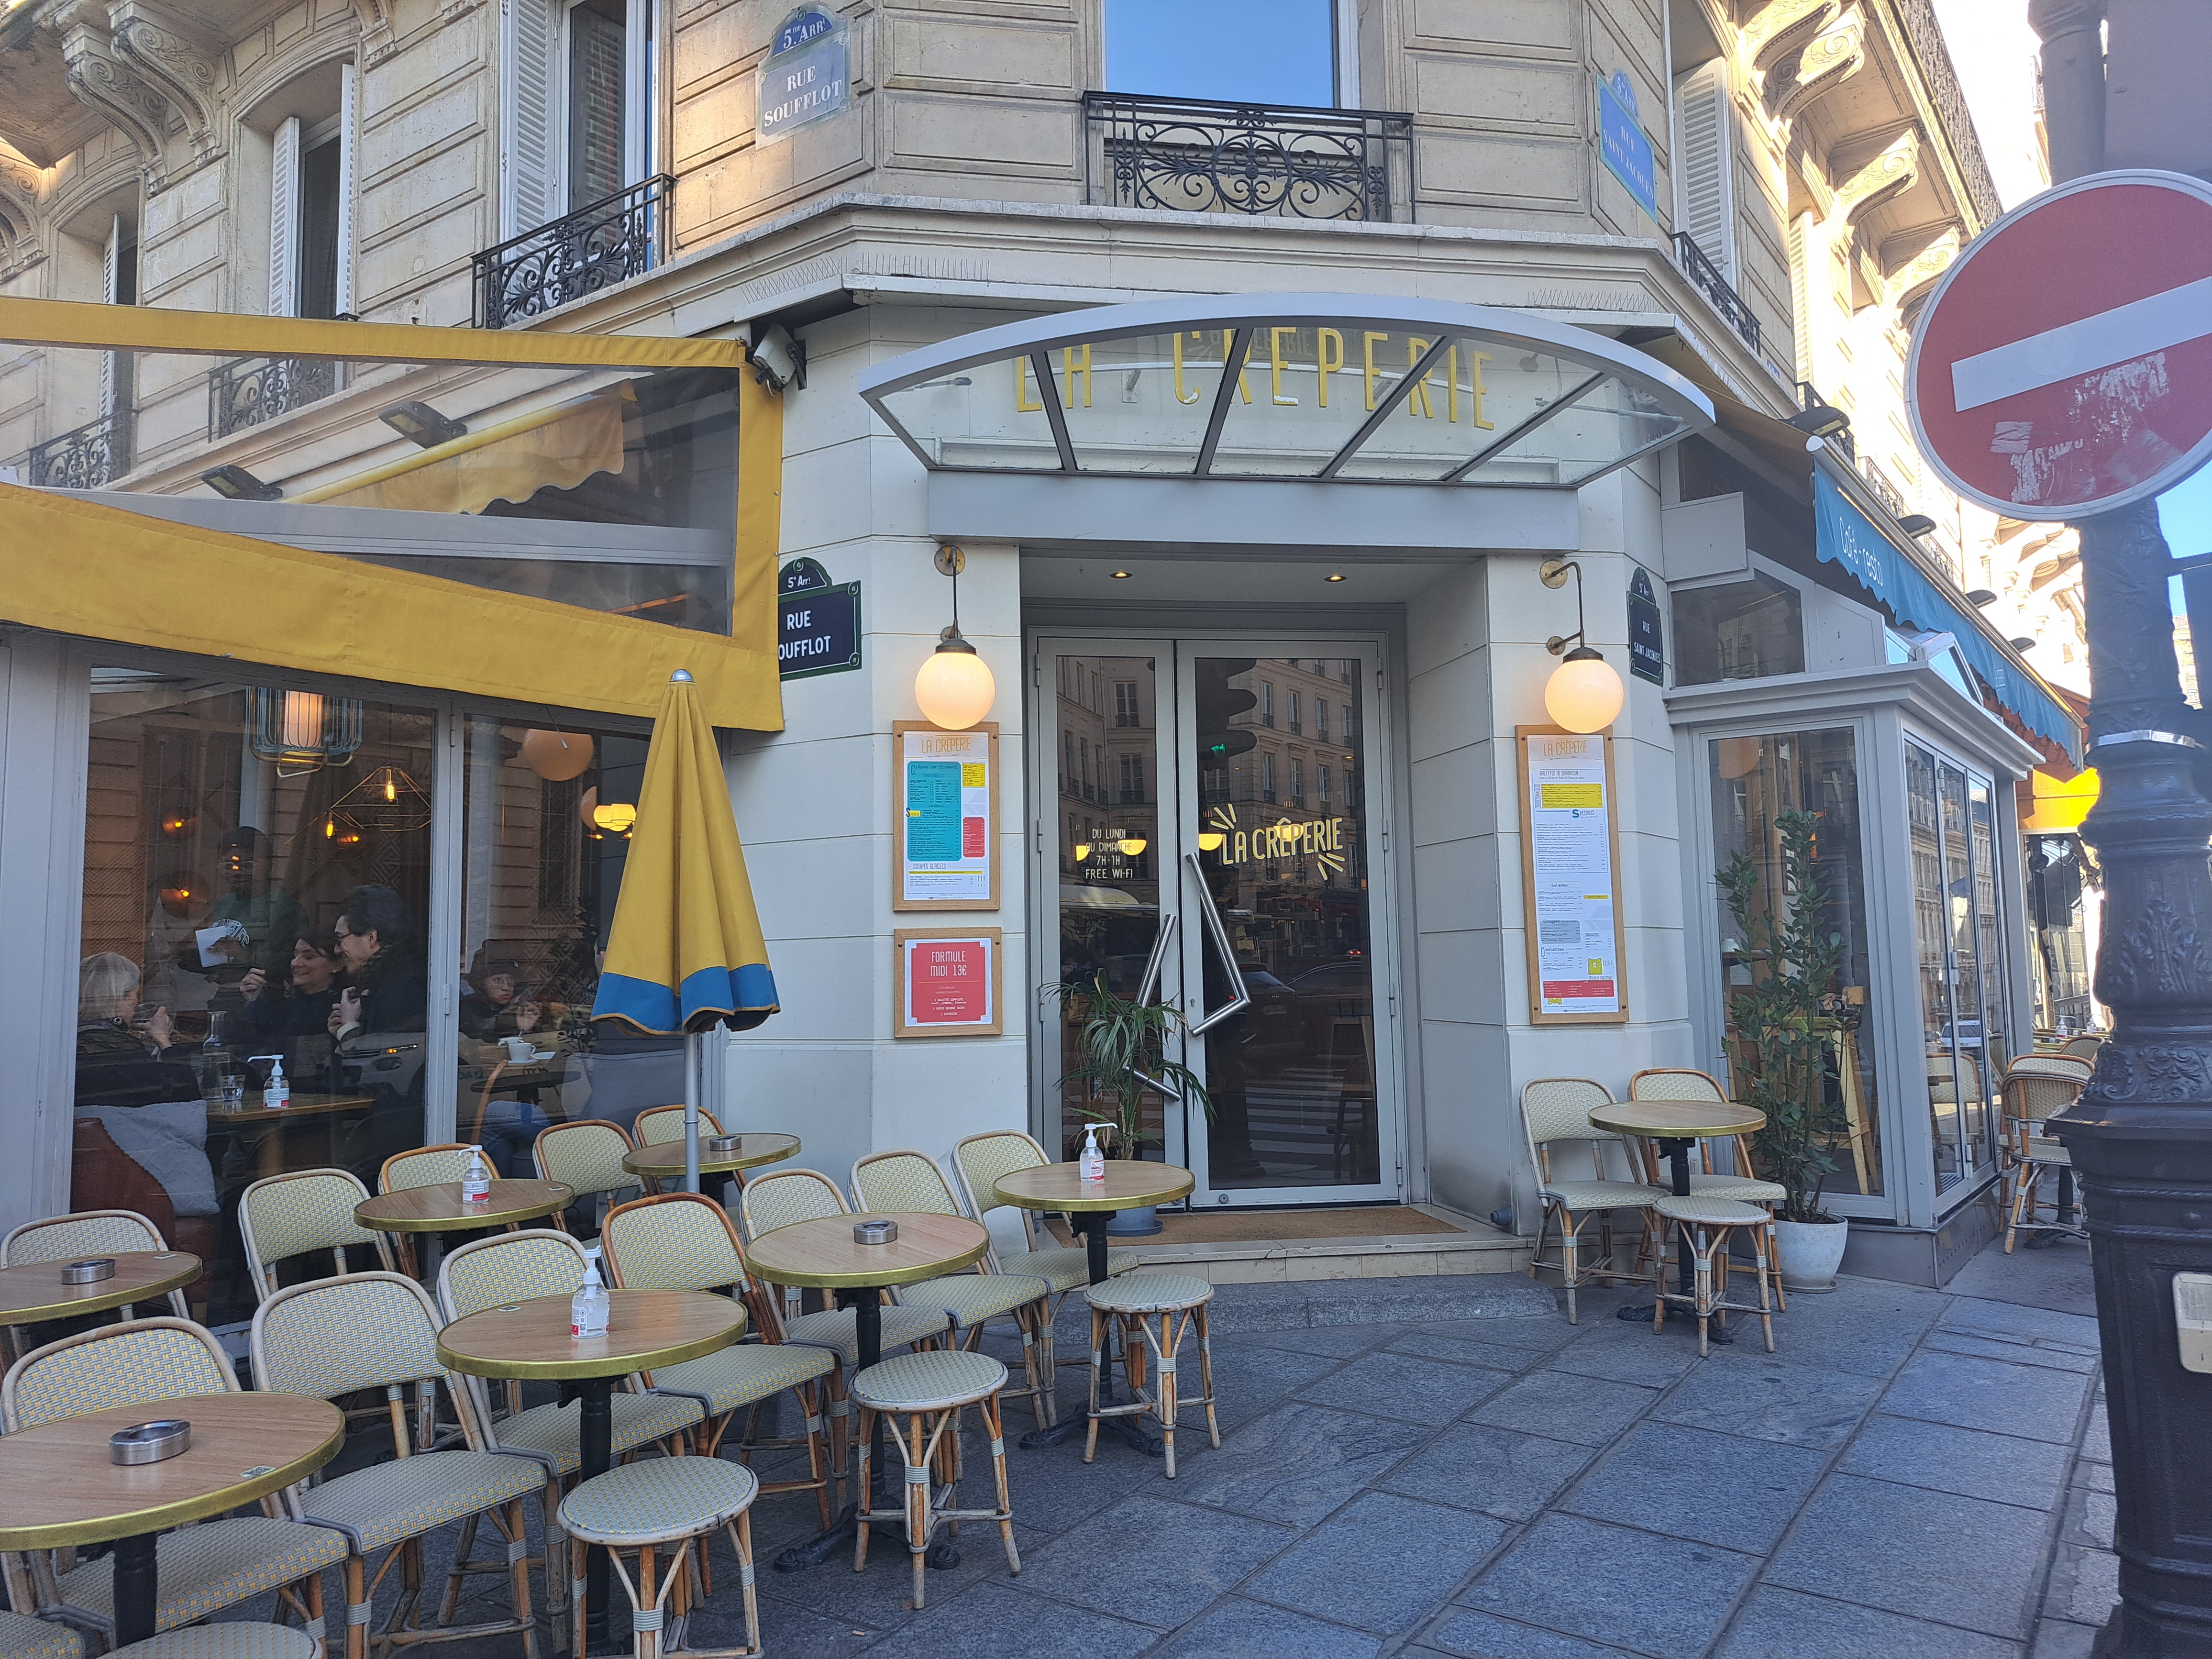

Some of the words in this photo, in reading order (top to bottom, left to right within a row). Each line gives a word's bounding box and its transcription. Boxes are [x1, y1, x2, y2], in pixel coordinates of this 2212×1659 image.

[786, 66, 816, 92] RUE
[764, 79, 842, 127] SOUFFLOT
[1621, 125, 1636, 154] RUE
[1603, 129, 1624, 162] SAINT
[1625, 156, 1654, 199] JACQUES
[787, 610, 811, 630] RUE
[1642, 620, 1651, 634] RUE
[778, 635, 831, 661] OUFFLOT
[1634, 641, 1645, 657] SAINT
[1645, 647, 1661, 664] JACQUES
[922, 740, 932, 754] LA
[935, 737, 971, 753] CRÊPERIE
[1543, 743, 1553, 757] LA
[1092, 829, 1104, 839] DU
[1106, 829, 1126, 839] LUNDI
[1221, 831, 1247, 865] LA
[1252, 817, 1343, 861] CRÊPERIE
[1085, 842, 1097, 852] AU
[1099, 842, 1133, 852] DIMANCHE
[1085, 869, 1108, 879] FREE
[1112, 869, 1133, 879] WI-FI
[931, 951, 965, 962] FORMULE
[930, 965, 947, 976] MIDI
[953, 965, 967, 976] 13€
